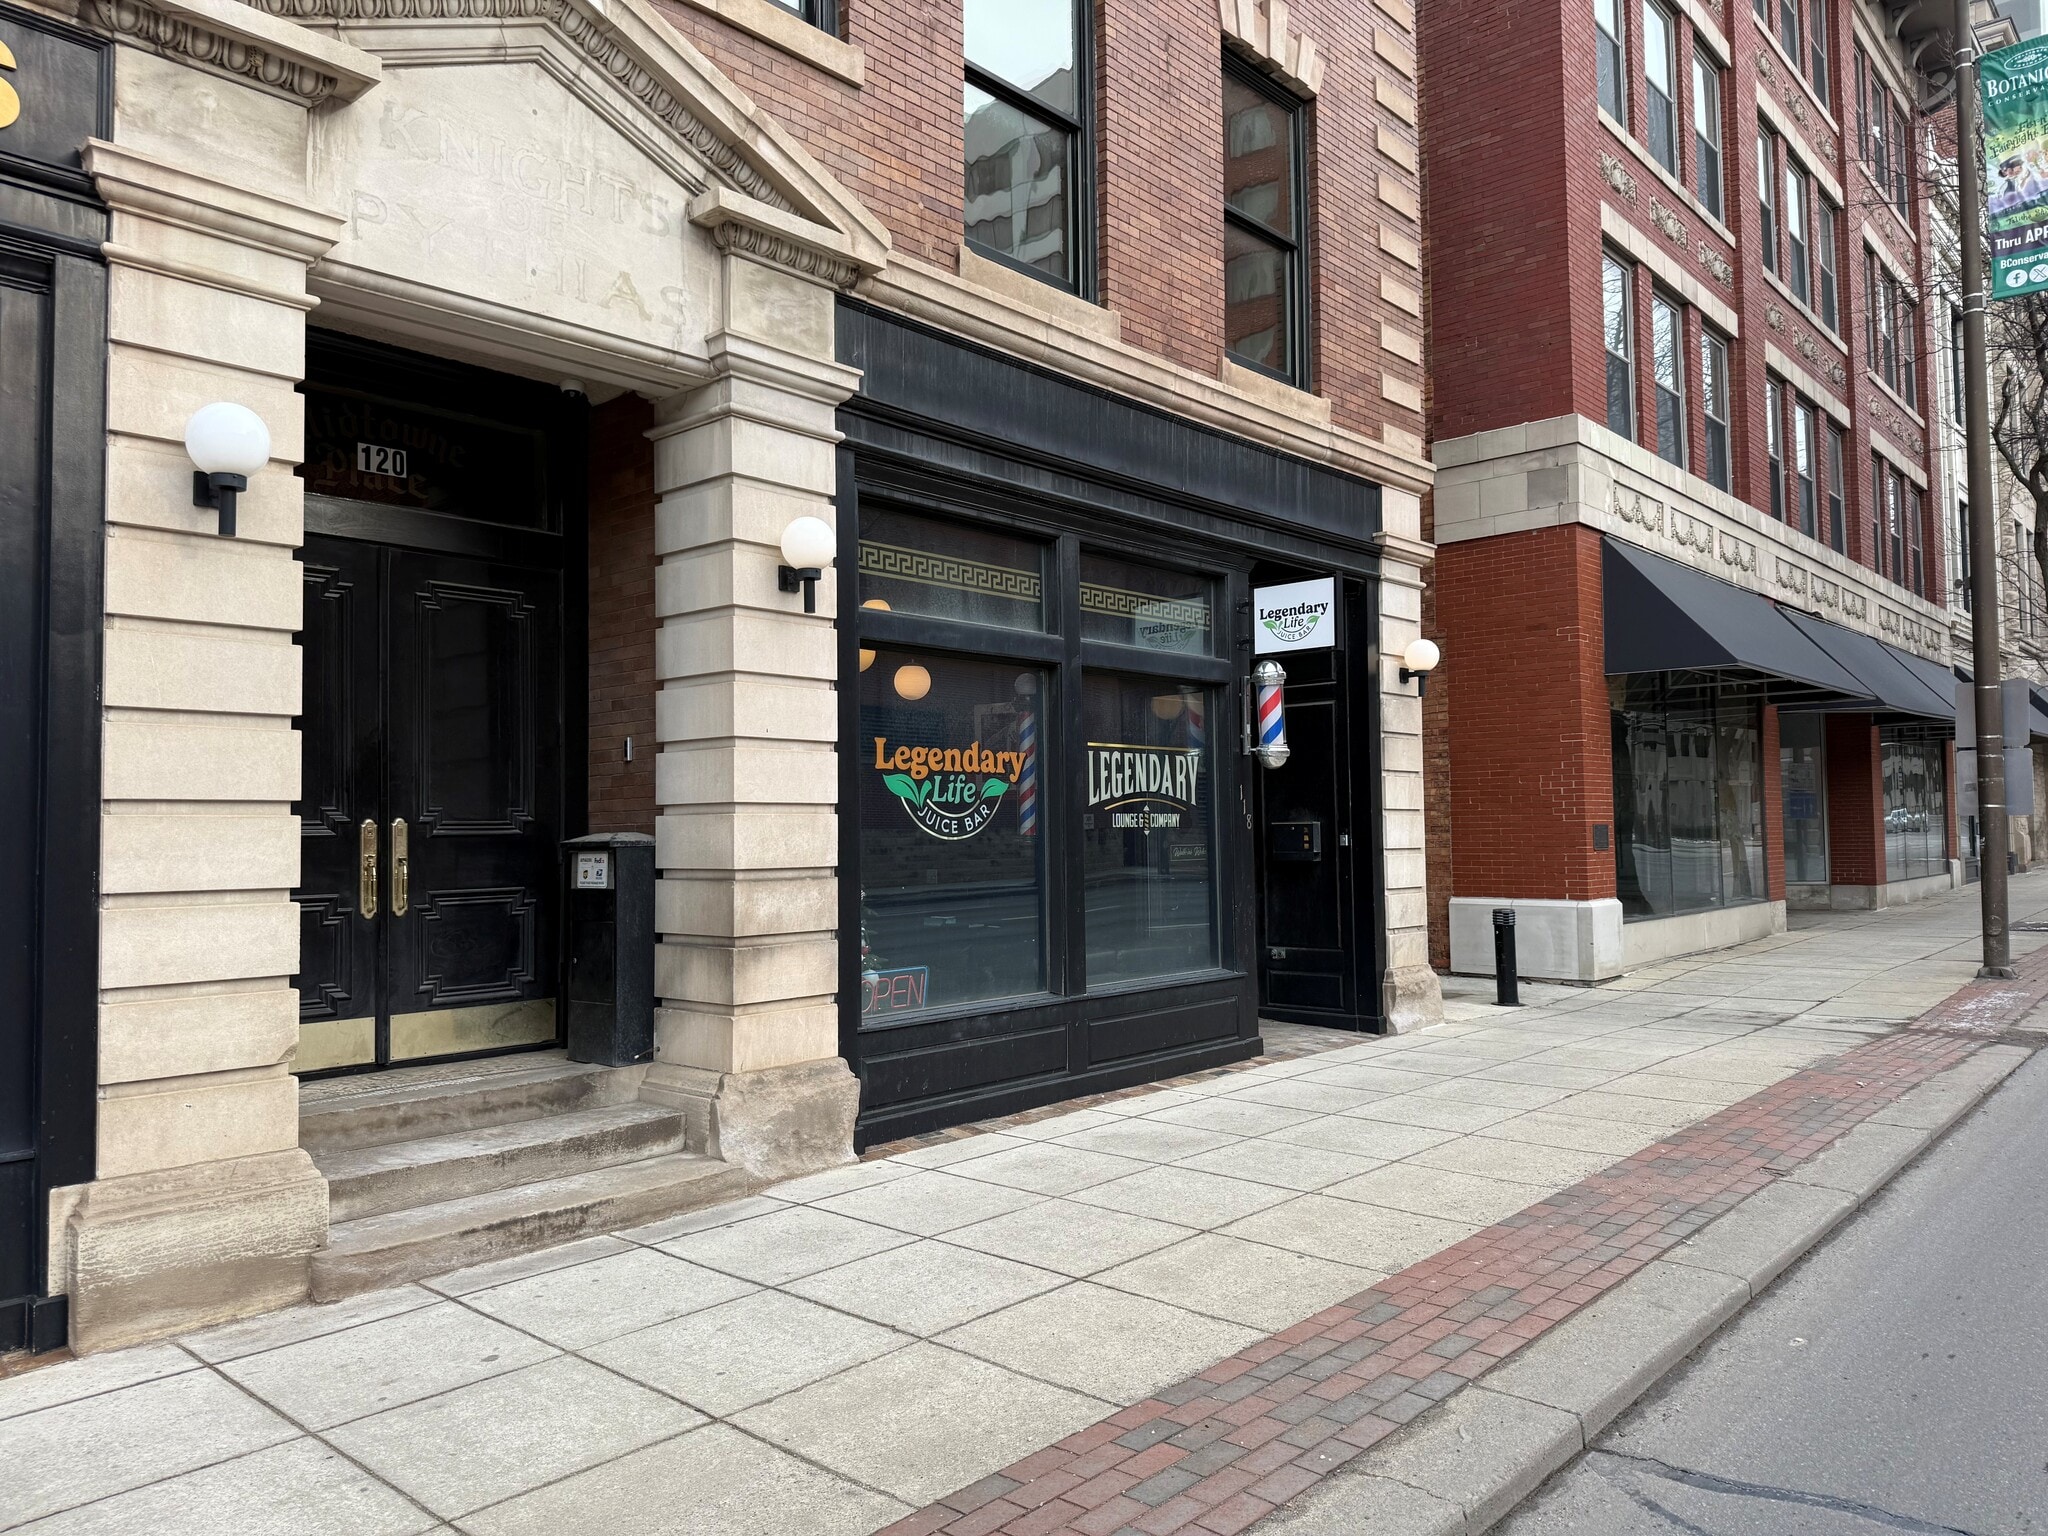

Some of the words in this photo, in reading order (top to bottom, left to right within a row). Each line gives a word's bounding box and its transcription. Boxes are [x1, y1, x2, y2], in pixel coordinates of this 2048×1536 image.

[1988, 83, 2048, 107] CONSERVA
[379, 99, 671, 238] KNIGHTS
[501, 193, 571, 244] OF
[1995, 236, 2021, 250] Thru
[361, 445, 405, 477] 120
[1259, 602, 1329, 622] Legendary
[1283, 616, 1304, 629] Life
[1277, 630, 1296, 640] JUICE
[1298, 625, 1312, 639] BAR
[874, 737, 1027, 783] Legendary
[932, 775, 977, 804] Life
[1087, 750, 1199, 807] LEGENDARY
[918, 806, 958, 834] JUICE
[964, 804, 991, 831] BAR
[1112, 813, 1138, 828] LOUNGE
[1150, 813, 1180, 828] COMPANY
[861, 973, 924, 1013] OPEN
